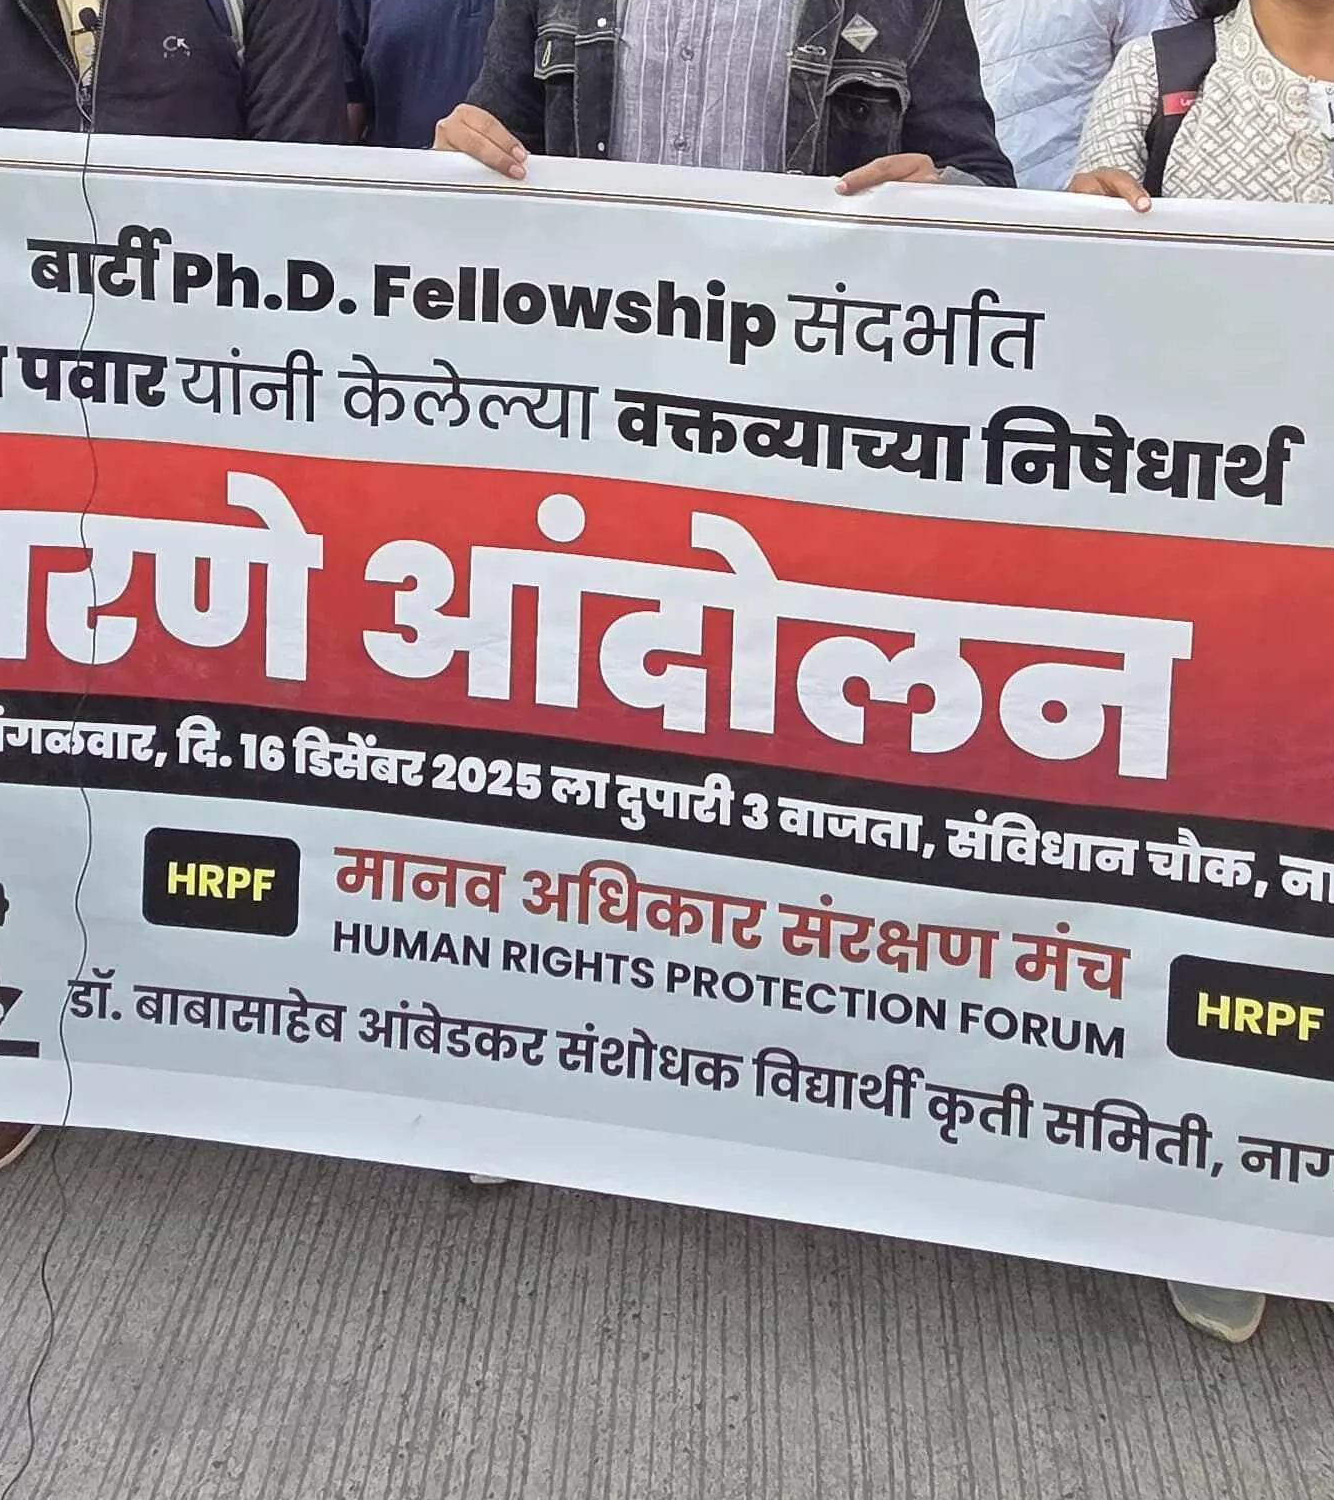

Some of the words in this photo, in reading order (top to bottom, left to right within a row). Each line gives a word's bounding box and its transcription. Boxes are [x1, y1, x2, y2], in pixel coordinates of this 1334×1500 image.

[26, 224, 173, 301] बार्टी
[173, 252, 358, 316] Ph.D.
[373, 264, 776, 365] Fellowship
[787, 281, 1045, 370] संदर्भात
[17, 346, 166, 408] पवार
[176, 346, 323, 422] यांनी
[338, 353, 598, 441] केलेल्या
[614, 389, 970, 482] वक्तव्याच्या
[981, 405, 1305, 506] निषेधार्थ
[361, 493, 1193, 780] आंदोलन
[168, 862, 276, 903] HRPF
[175, 715, 230, 768] दि.
[241, 734, 286, 771] 16
[293, 726, 427, 785] डिसेंबर
[433, 756, 541, 799] 2025
[550, 765, 608, 809] ला
[616, 773, 732, 828] दुपारी
[741, 794, 768, 829] 3
[779, 797, 934, 860] वाजता,
[946, 808, 1135, 877] संविधान
[1147, 828, 1267, 898] चौक,
[334, 847, 506, 913] मानव
[522, 860, 767, 949] अधिकार
[780, 893, 999, 978] संरक्षण
[1013, 921, 1132, 1000] मंच
[334, 921, 490, 970] HUMAN
[503, 939, 654, 990] RIGHTS
[667, 961, 946, 1032] PROTECTION
[960, 1002, 1126, 1059] FORUM
[68, 968, 121, 1021] डॉ.
[133, 984, 346, 1044] बाबासाहेब
[359, 1000, 547, 1067] आंबेडकर
[556, 1022, 743, 1094] संशोधक
[753, 1046, 924, 1118] विद्यार्थी
[928, 1083, 1032, 1143] कृती
[1044, 1097, 1224, 1179] समिती,
[1197, 992, 1324, 1042] HRPF
